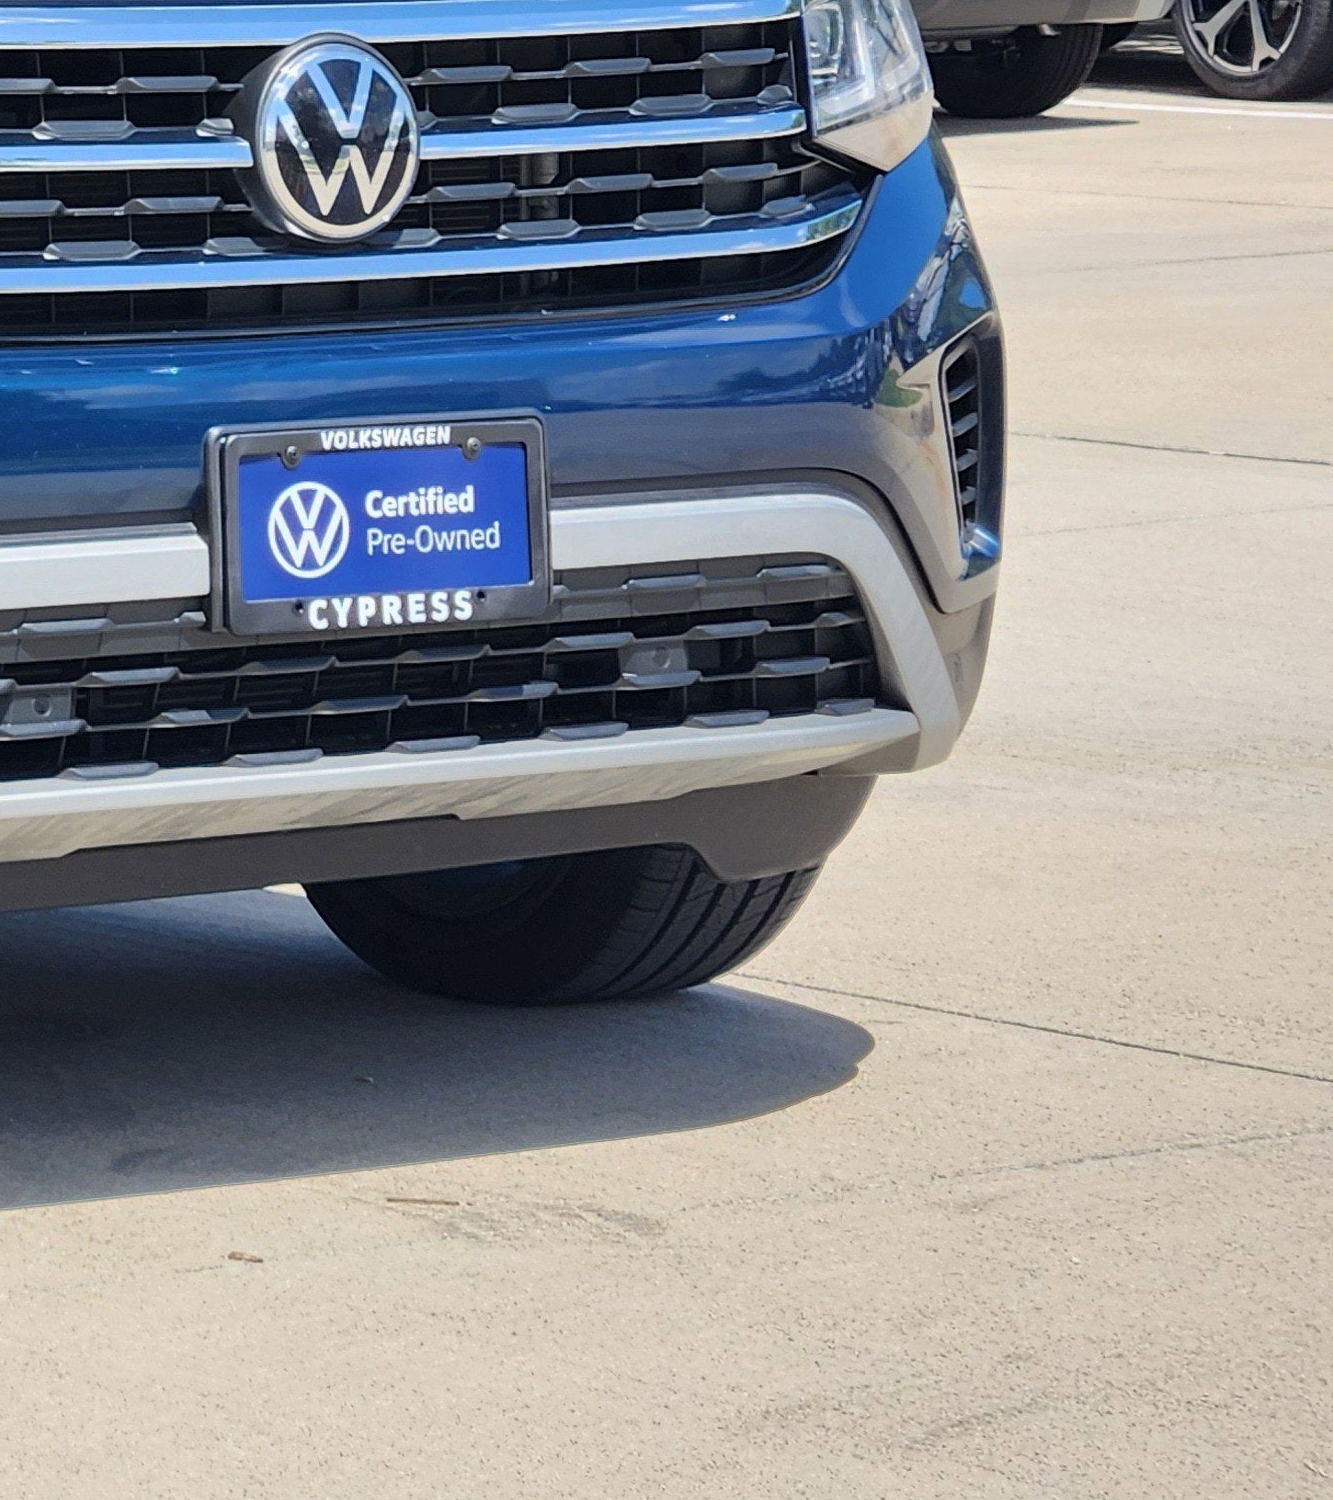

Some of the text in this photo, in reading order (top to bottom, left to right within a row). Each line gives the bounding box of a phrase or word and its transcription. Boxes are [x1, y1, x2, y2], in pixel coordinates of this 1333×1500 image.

[263, 45, 416, 235] VW
[320, 425, 451, 451] VOLKSWAGEN
[364, 485, 475, 519] Certified
[269, 482, 349, 578] VW
[366, 520, 500, 556] Pre-Owned
[307, 590, 473, 631] CYPRESS
